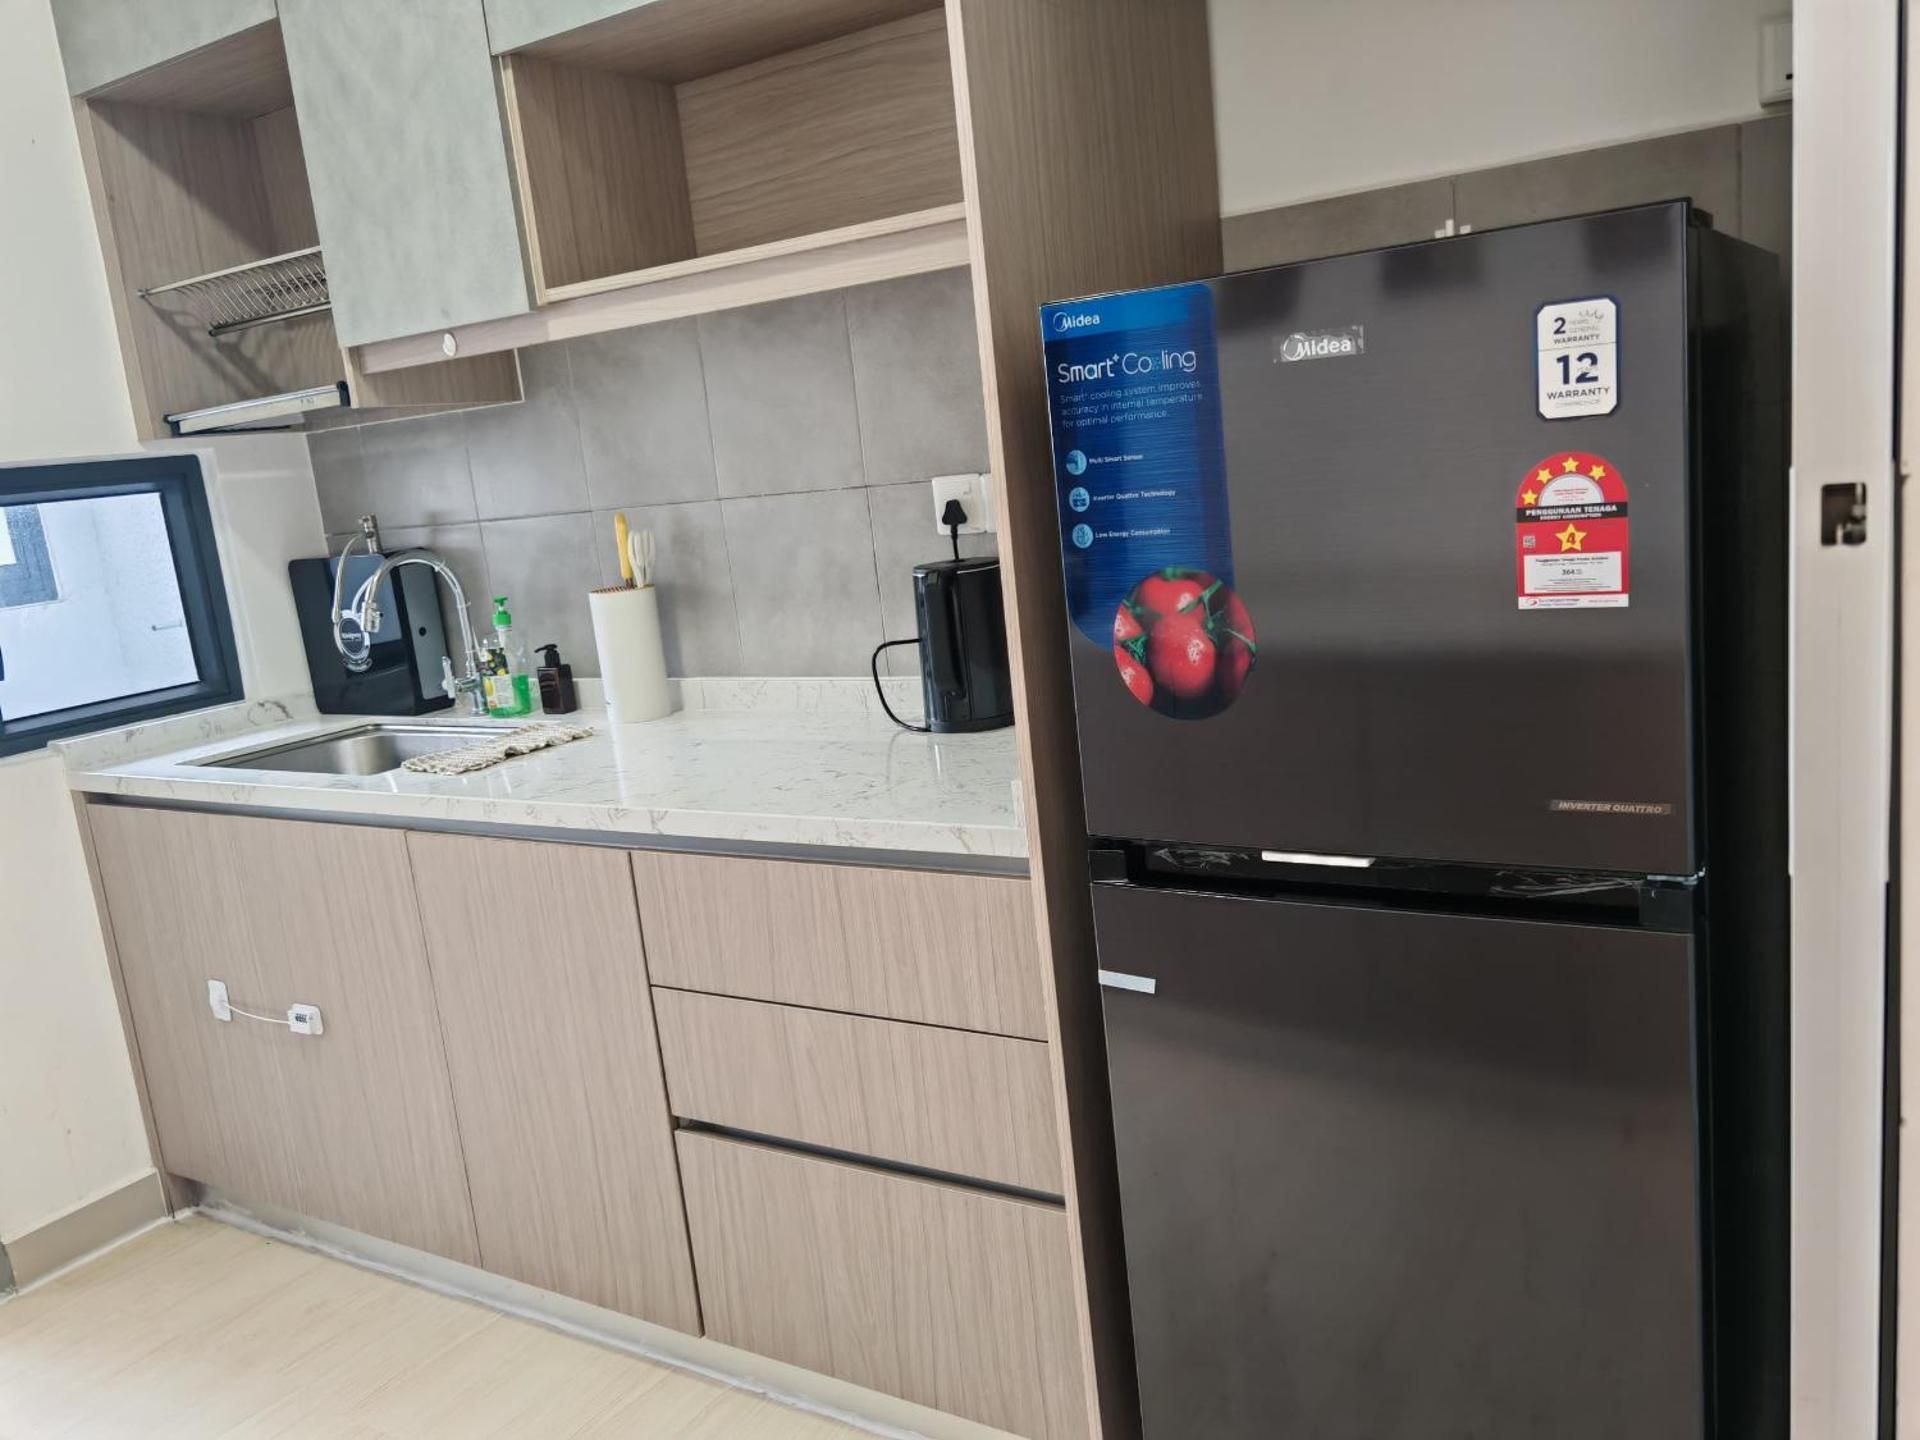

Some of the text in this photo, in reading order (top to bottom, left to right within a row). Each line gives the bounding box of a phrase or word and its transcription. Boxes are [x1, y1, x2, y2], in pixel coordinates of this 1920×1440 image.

[1053, 312, 1100, 332] Midea
[1553, 317, 1566, 335] 2
[1553, 334, 1600, 344] WARRANTY
[1283, 334, 1352, 361] Midea
[1556, 352, 1599, 385] 12
[1090, 389, 1122, 401] cooling
[1123, 385, 1157, 398] system
[1157, 380, 1201, 394] improves
[1546, 387, 1610, 400] WARRANTY
[1061, 393, 1204, 417] accuracy in internal temperature
[1063, 419, 1075, 429] for
[1076, 415, 1109, 428] optimal
[1526, 504, 1618, 517] PENGGUNAAN TENAGA
[1566, 532, 1577, 545] 4
[1561, 568, 1576, 576] 364
[1558, 801, 1663, 814] INVERTER QUATTRO
